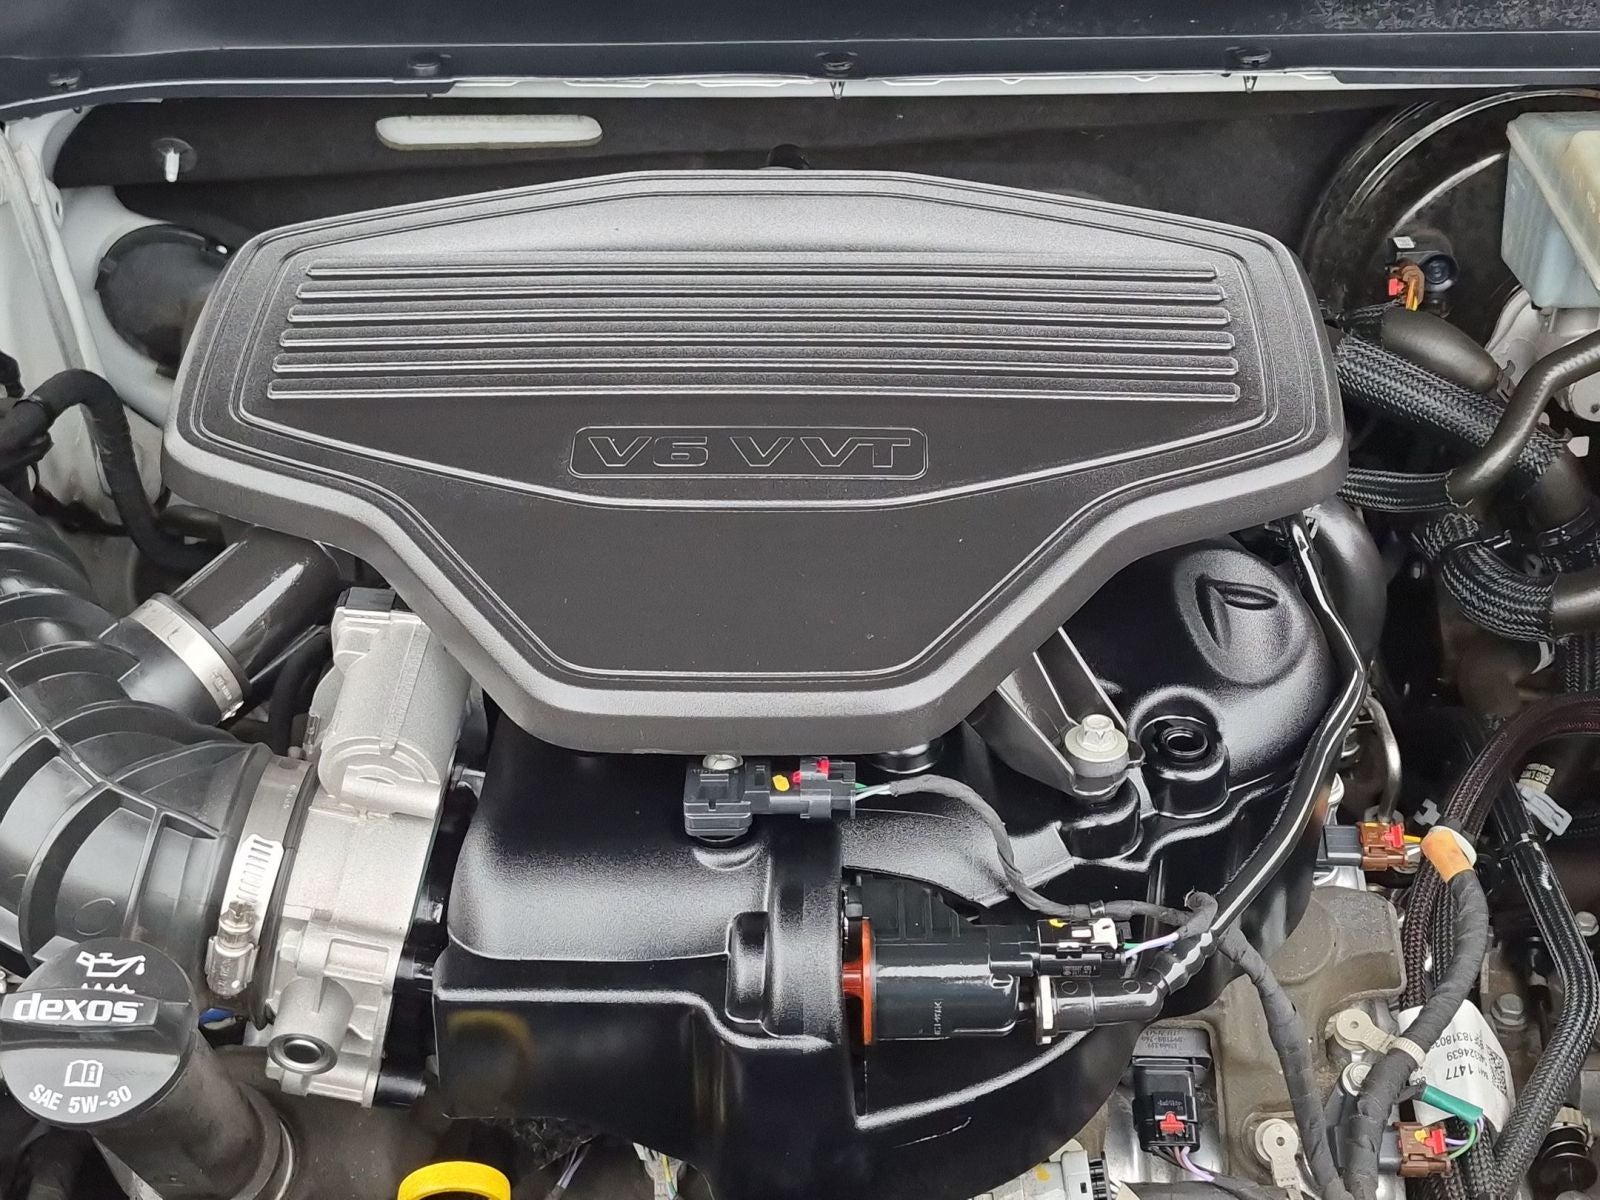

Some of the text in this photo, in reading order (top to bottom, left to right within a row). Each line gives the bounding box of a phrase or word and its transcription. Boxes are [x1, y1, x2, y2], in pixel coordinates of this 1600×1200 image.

[588, 436, 911, 468] V6 VVT
[12, 992, 140, 1023] dexos
[1445, 1063, 1474, 1080] 1477
[28, 1083, 132, 1114] SAE 5W-30
